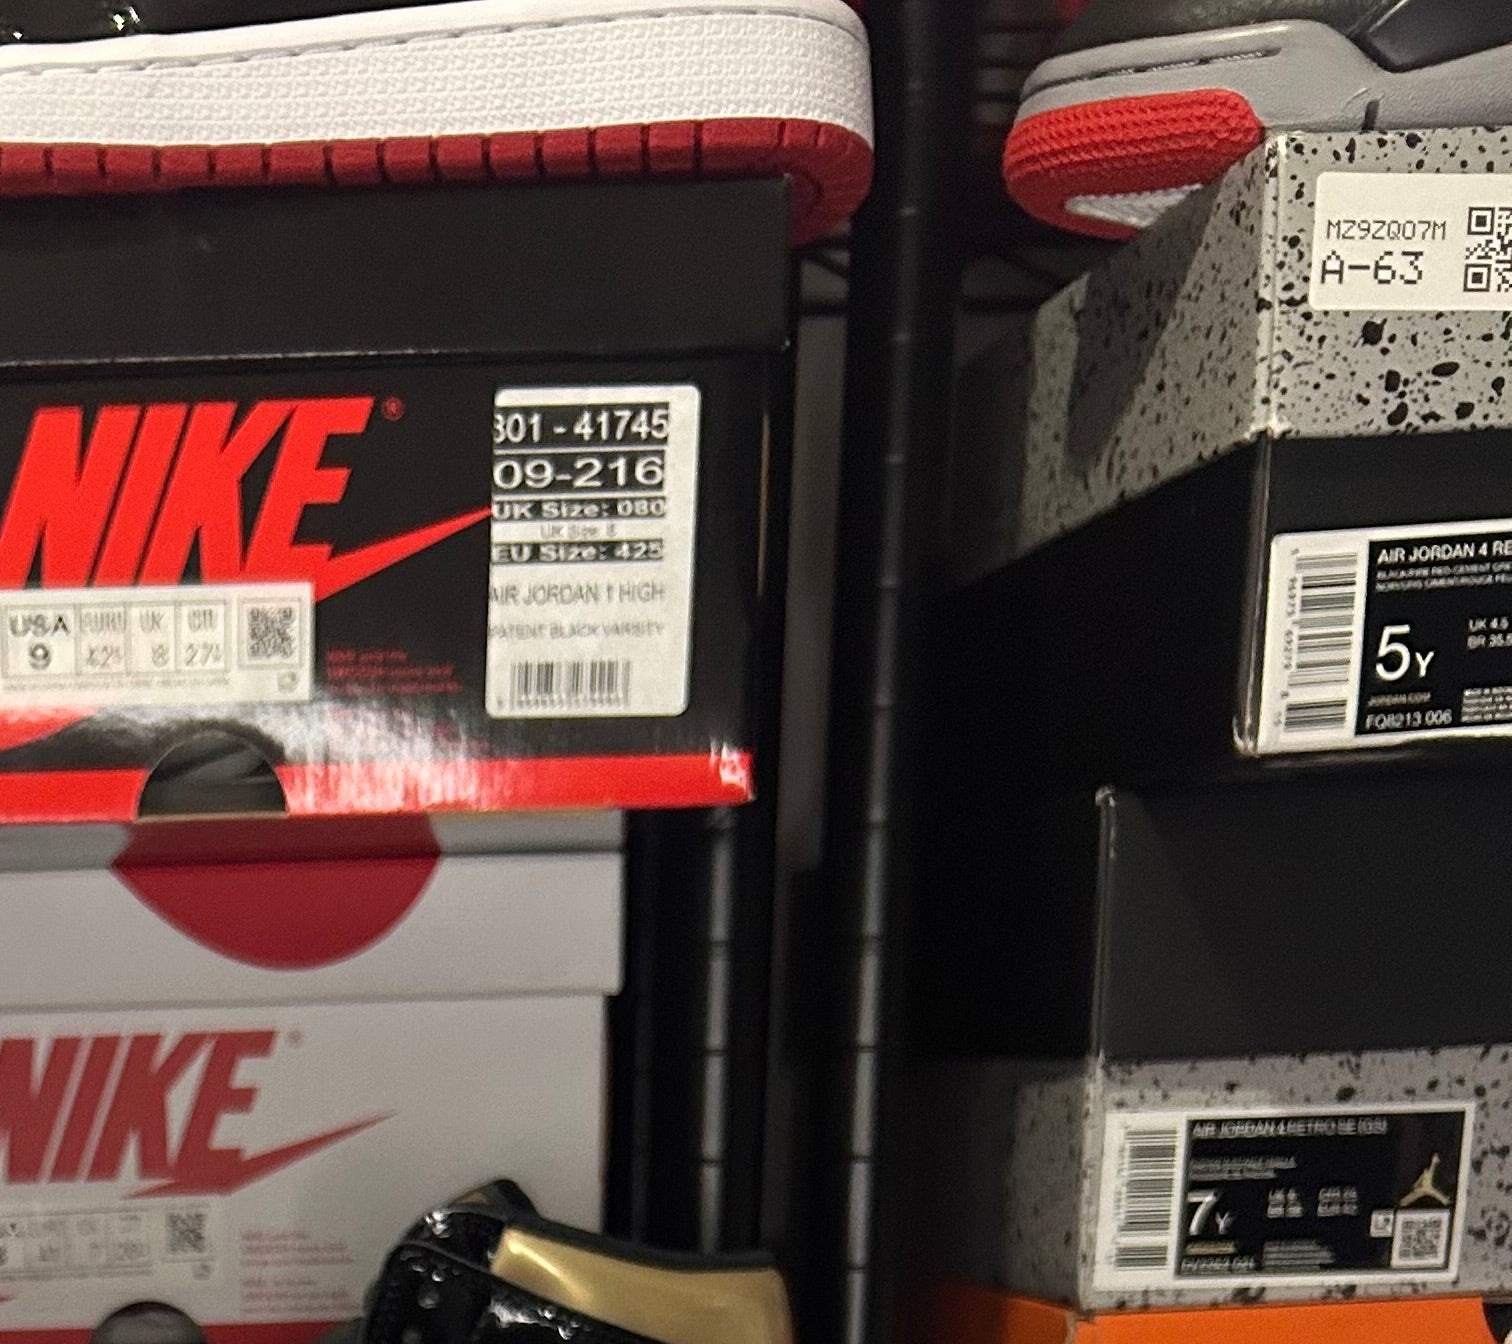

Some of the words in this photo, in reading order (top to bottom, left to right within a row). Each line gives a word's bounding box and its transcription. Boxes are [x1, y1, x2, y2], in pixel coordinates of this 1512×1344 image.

[1320, 251, 1425, 285] A-63
[573, 408, 669, 441] 41745
[493, 455, 664, 490] 09-216
[493, 501, 536, 520] UK
[541, 500, 610, 520] Size:
[491, 543, 534, 564] EU
[539, 543, 608, 562] Size:
[614, 541, 664, 561] 425
[1377, 547, 1406, 565] AIR
[1408, 542, 1476, 563] JORDAN
[1477, 541, 1489, 557] 4
[490, 583, 520, 603] AIR
[522, 581, 599, 606] JORDAN
[618, 580, 665, 604] HIGH
[8, 614, 71, 638] USA
[27, 641, 53, 671] 9
